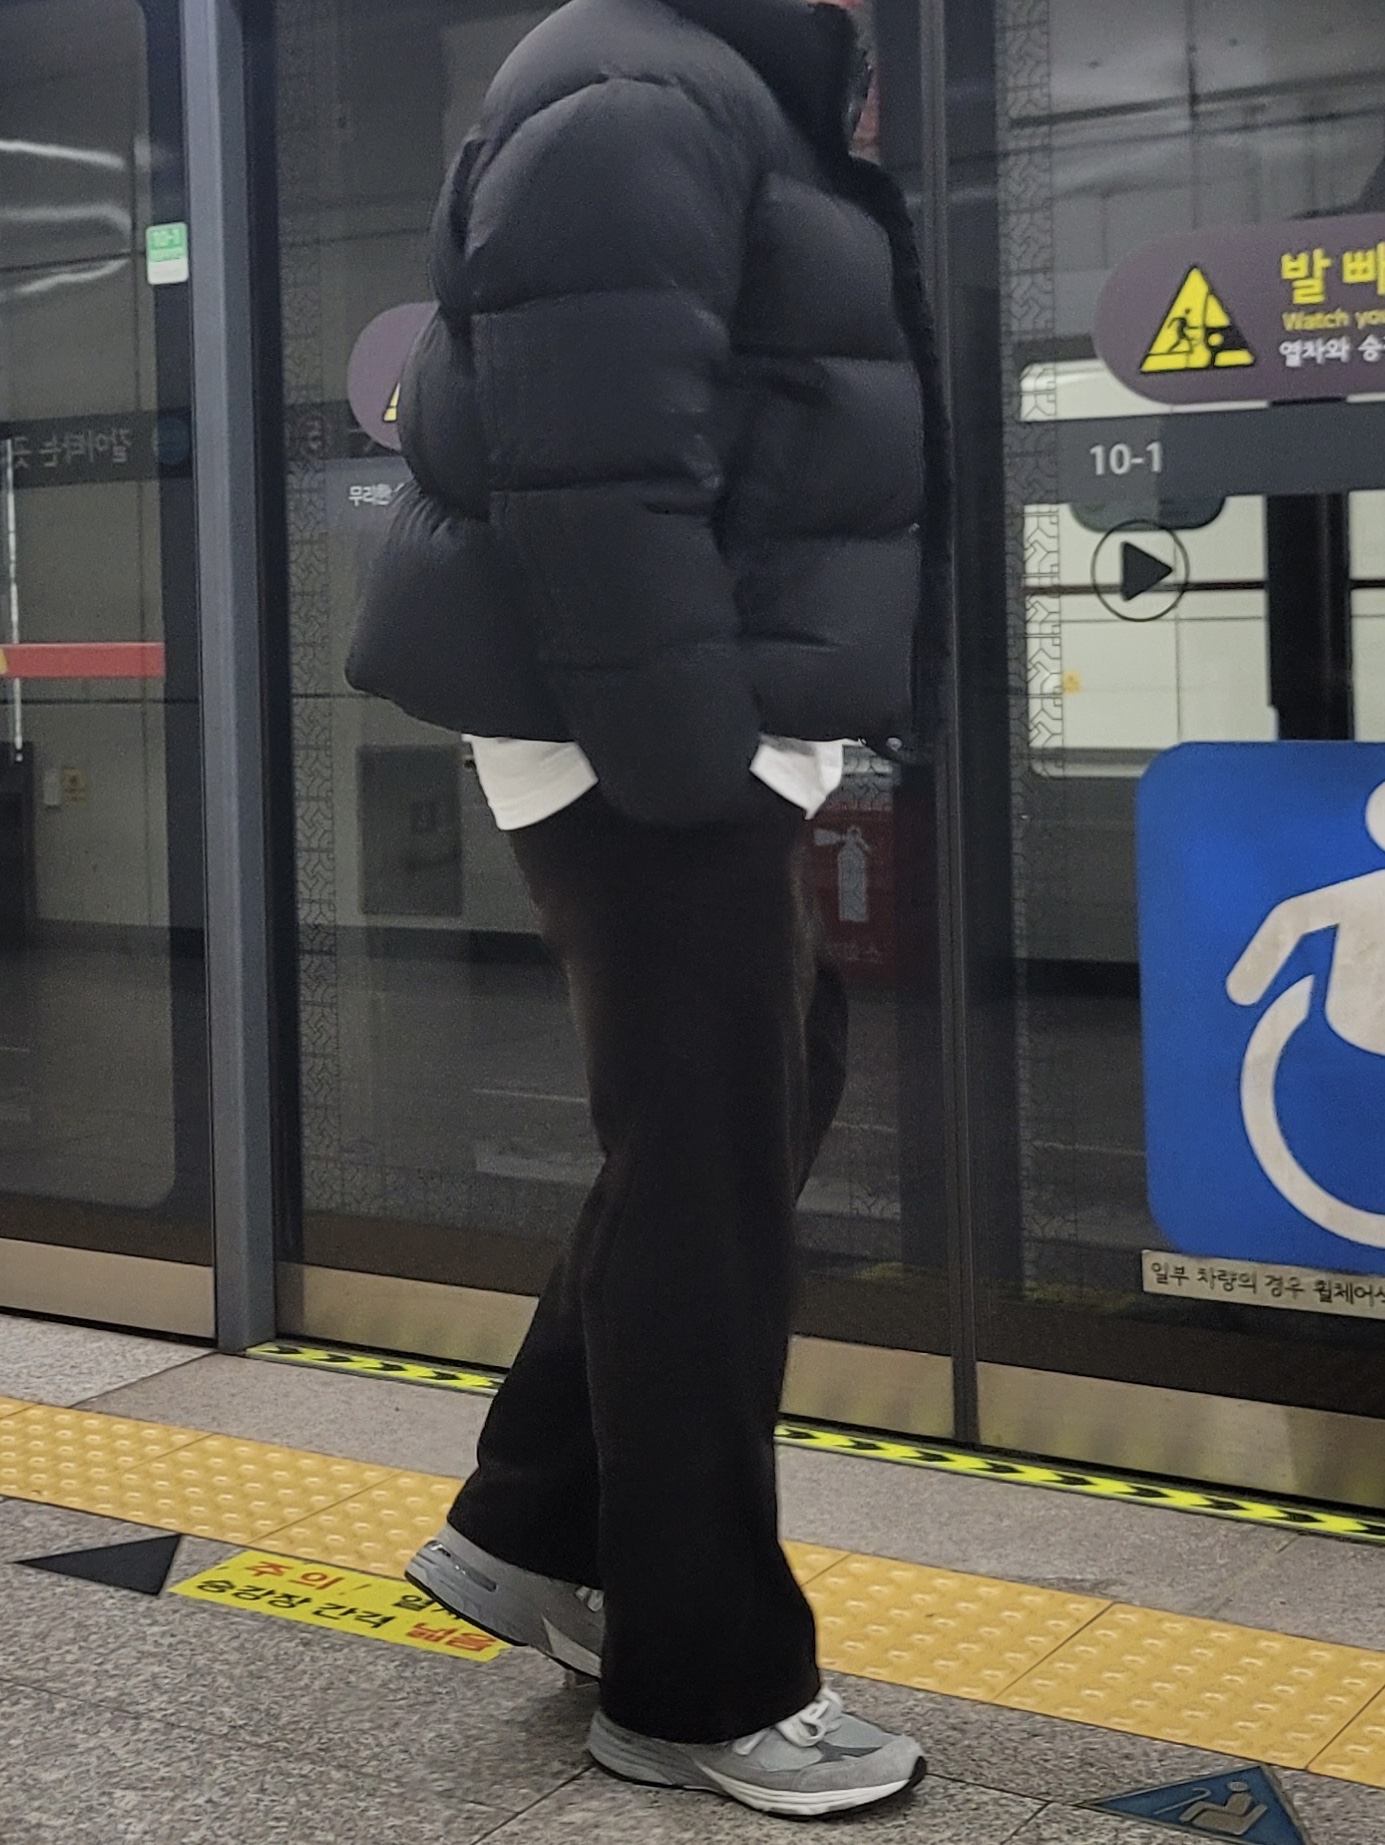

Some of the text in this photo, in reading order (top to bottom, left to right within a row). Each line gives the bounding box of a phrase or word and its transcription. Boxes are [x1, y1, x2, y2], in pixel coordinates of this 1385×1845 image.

[1282, 308, 1350, 331] Watch
[1279, 334, 1385, 367] 열차와 승
[1089, 441, 1162, 476] 10-1
[1151, 1262, 1189, 1287] 일부
[1197, 1266, 1257, 1294] 차량의
[1264, 1274, 1306, 1300] 경우
[197, 1579, 312, 1609] 승강장
[312, 1602, 396, 1629] 간격
